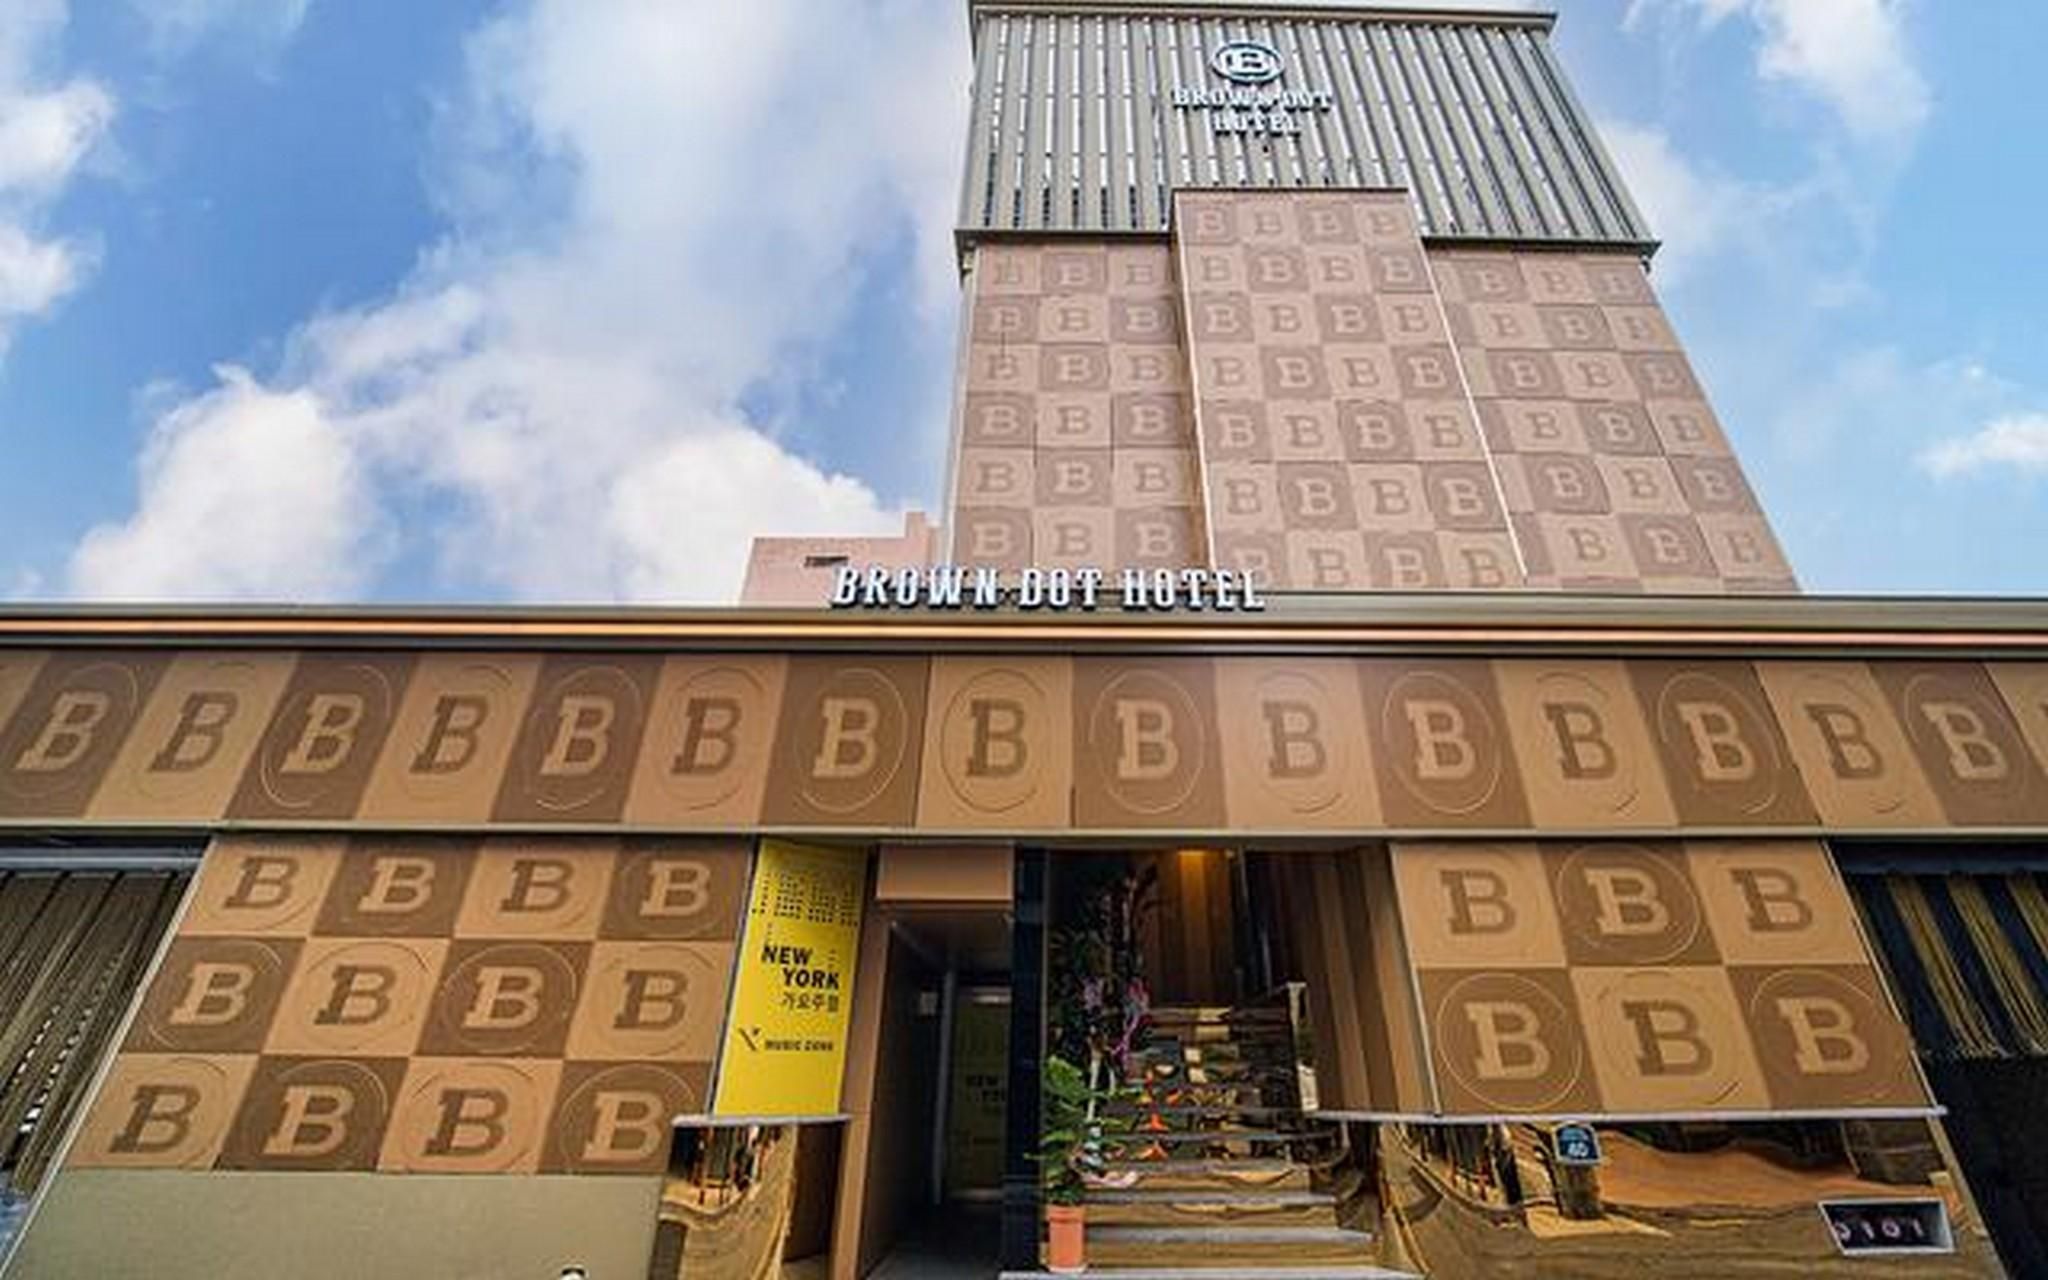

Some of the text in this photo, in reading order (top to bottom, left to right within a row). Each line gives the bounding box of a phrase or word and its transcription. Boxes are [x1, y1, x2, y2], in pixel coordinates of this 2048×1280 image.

[1202, 255, 1413, 282] B B B B
[1206, 305, 1429, 333] B B B B
[1213, 357, 1446, 388] B B B B
[982, 406, 1165, 434] B B B
[1218, 414, 1464, 449] B B B B
[1525, 413, 1560, 439] B
[1600, 413, 1636, 442] B
[976, 463, 1169, 493] B B B
[1547, 467, 1584, 497] B
[1623, 469, 1660, 497] B
[1226, 478, 1484, 516] B B B B
[973, 523, 1174, 556] B B B
[1568, 528, 1607, 560] B
[1645, 529, 1686, 563] B
[1307, 549, 1347, 586] B
[1383, 549, 1426, 586] B
[1461, 550, 1505, 586] B
[833, 567, 1265, 607] BROWN DOT HOTEL
[14, 692, 2008, 781] B B B B B B B B B B B B B B B
[224, 856, 710, 916] B B B B
[1440, 868, 1813, 936] B B B
[761, 946, 813, 965] NEW
[783, 967, 839, 989] YORK
[169, 962, 688, 1030] B B B B
[1464, 997, 1871, 1079] B B B
[109, 1084, 665, 1162] B B B B
